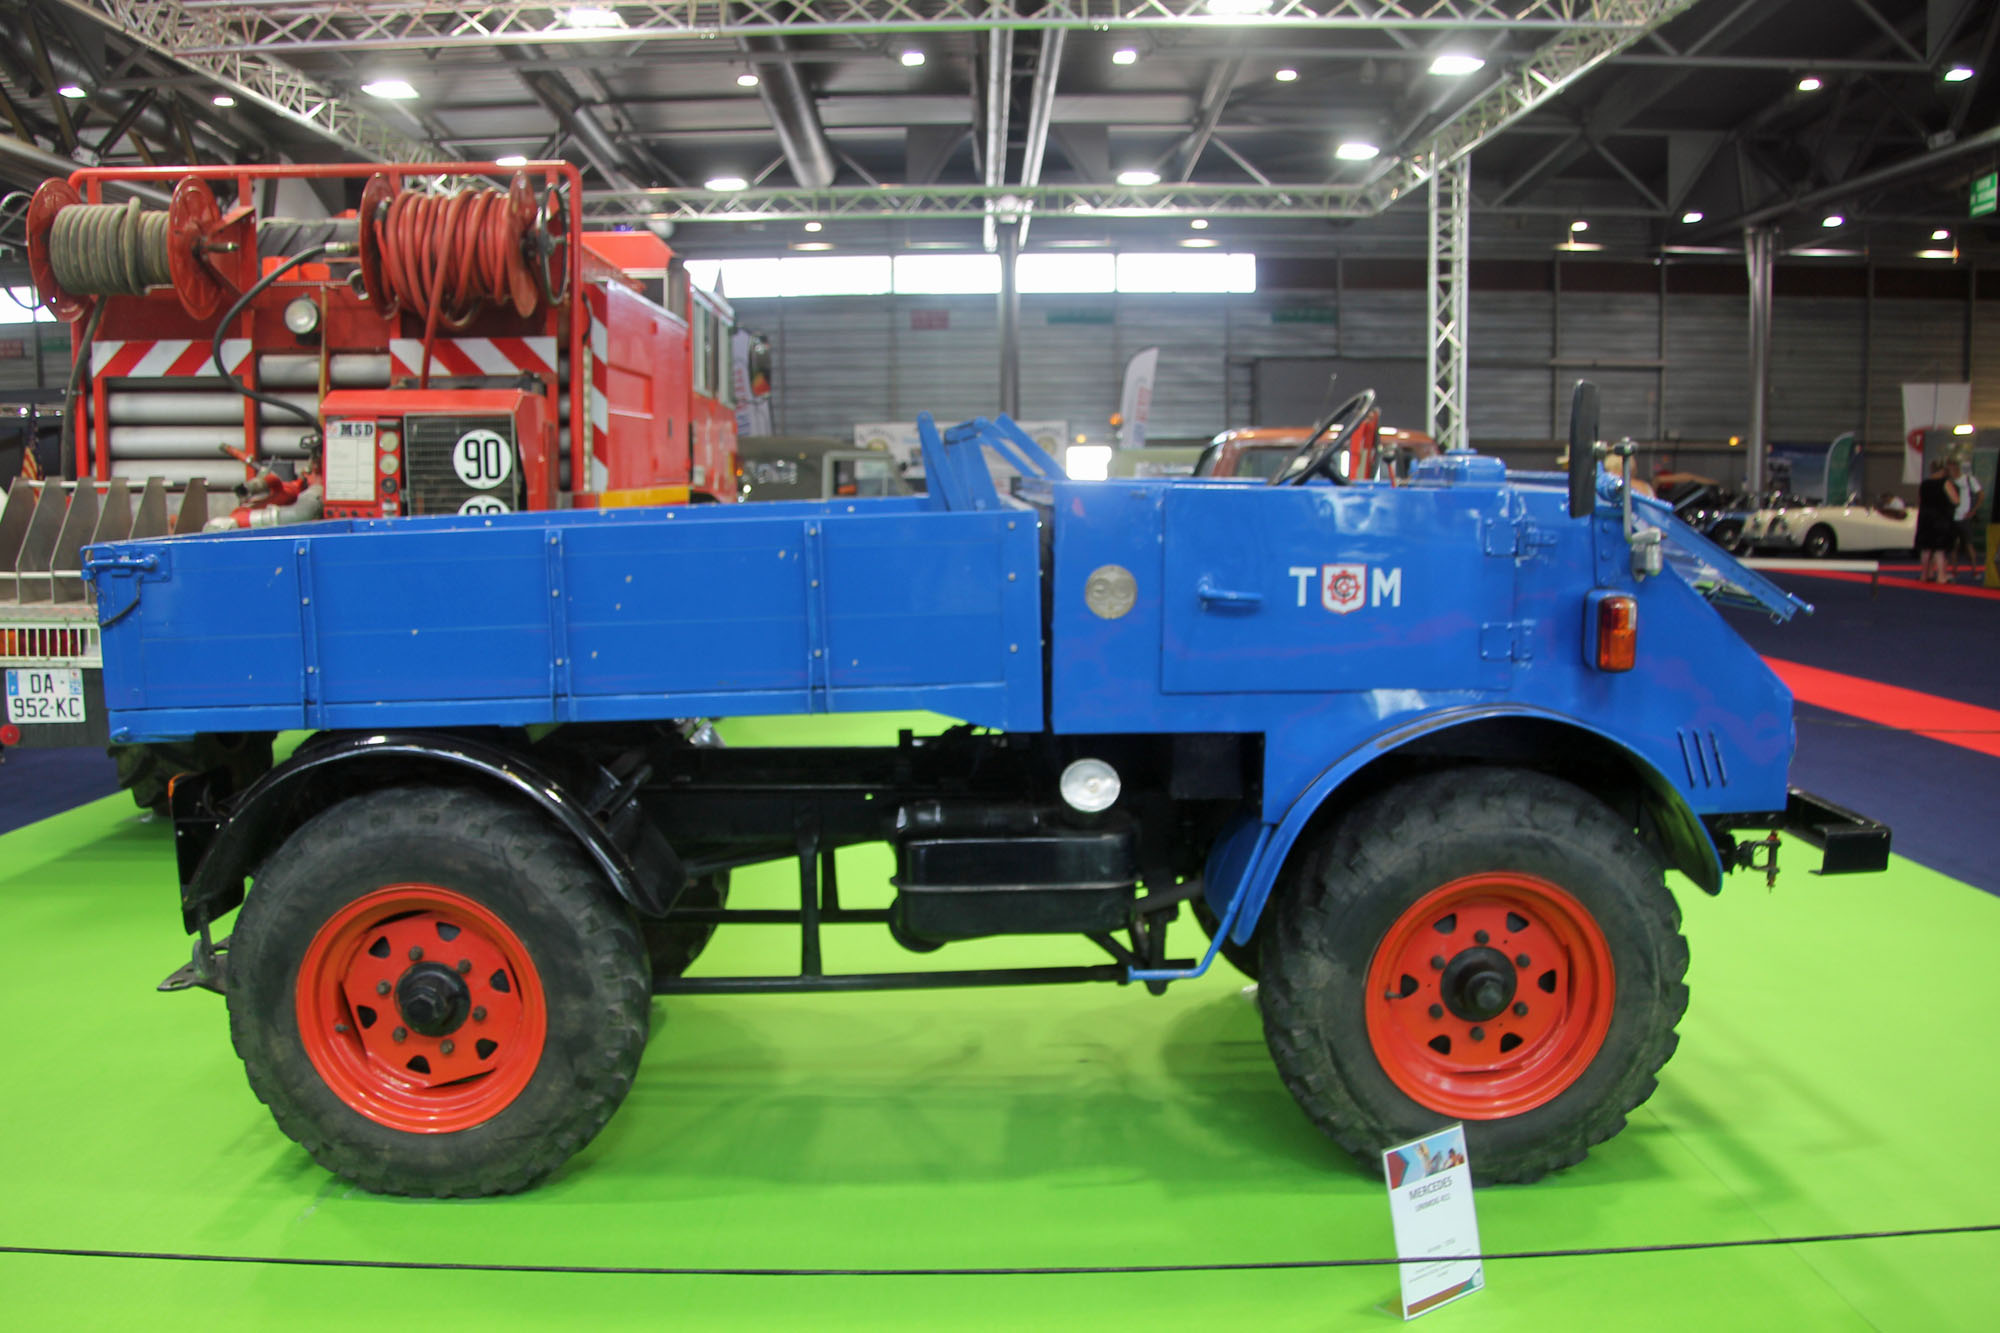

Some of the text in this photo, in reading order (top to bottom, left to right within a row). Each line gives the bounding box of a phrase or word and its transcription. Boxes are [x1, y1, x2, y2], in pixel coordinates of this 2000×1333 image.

[464, 439, 501, 479] 90
[1289, 566, 1317, 607] T
[1371, 567, 1402, 607] M
[1409, 1176, 1453, 1200] MERCEDES
